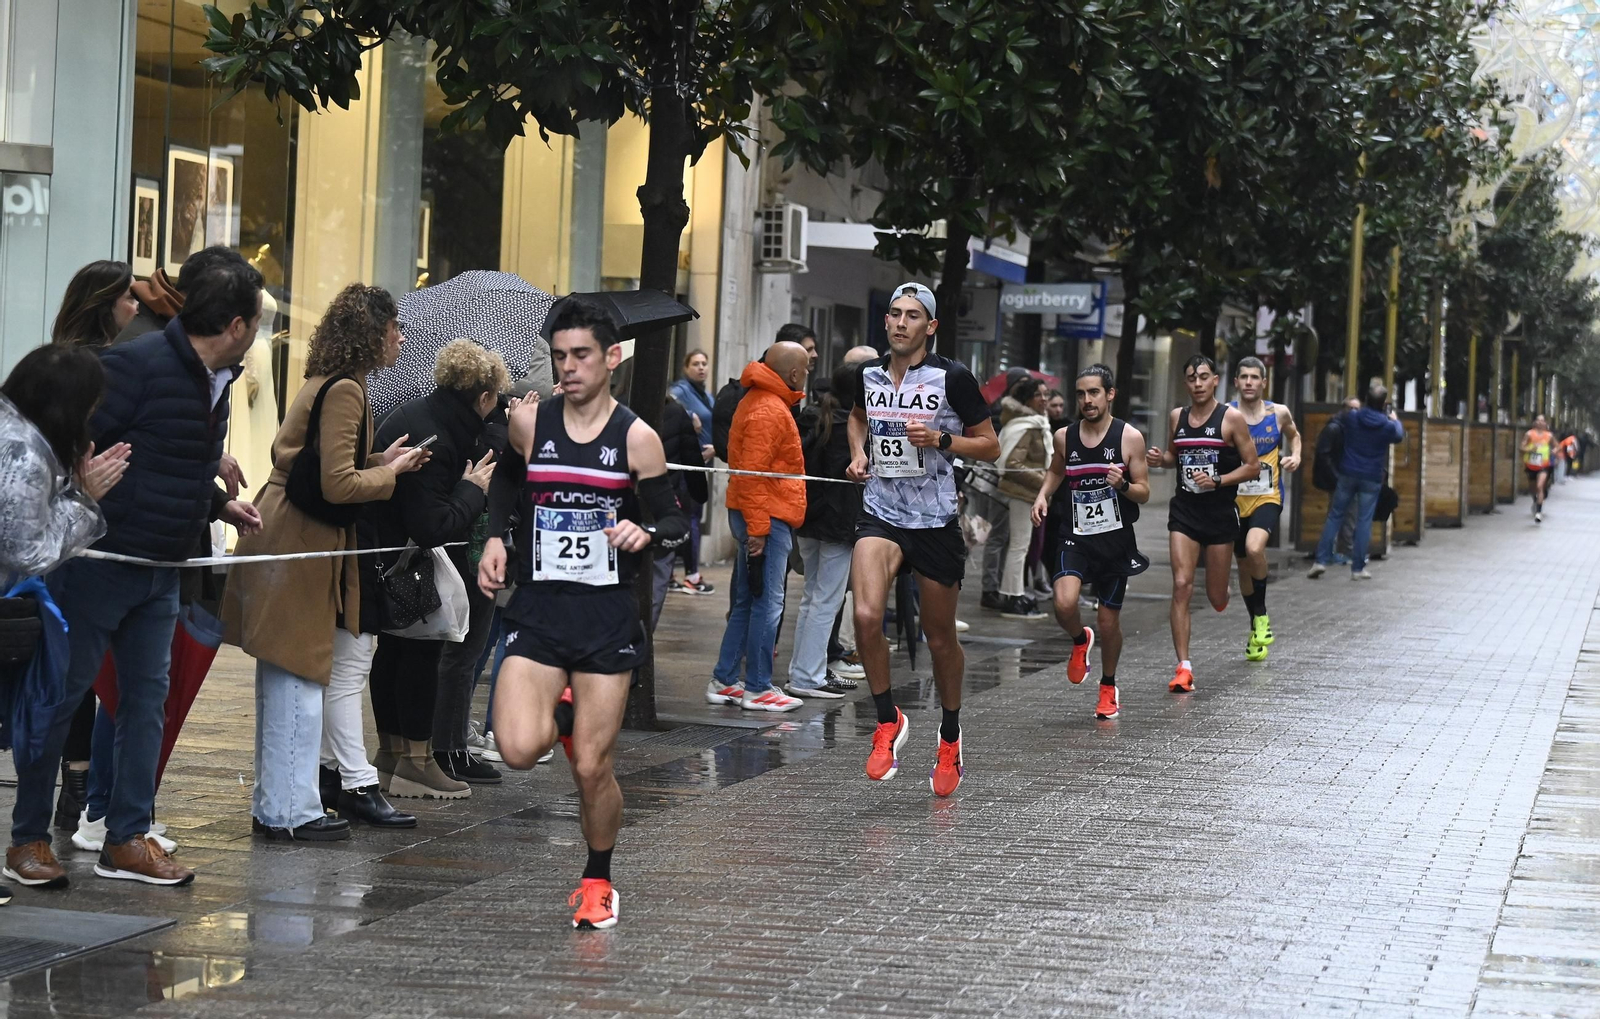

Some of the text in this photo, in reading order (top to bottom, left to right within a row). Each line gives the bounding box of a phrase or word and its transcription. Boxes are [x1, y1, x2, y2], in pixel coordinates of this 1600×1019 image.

[867, 391, 939, 410] KAILAS
[881, 439, 903, 457] 63
[1085, 503, 1104, 519] 24
[558, 536, 590, 559] 25
